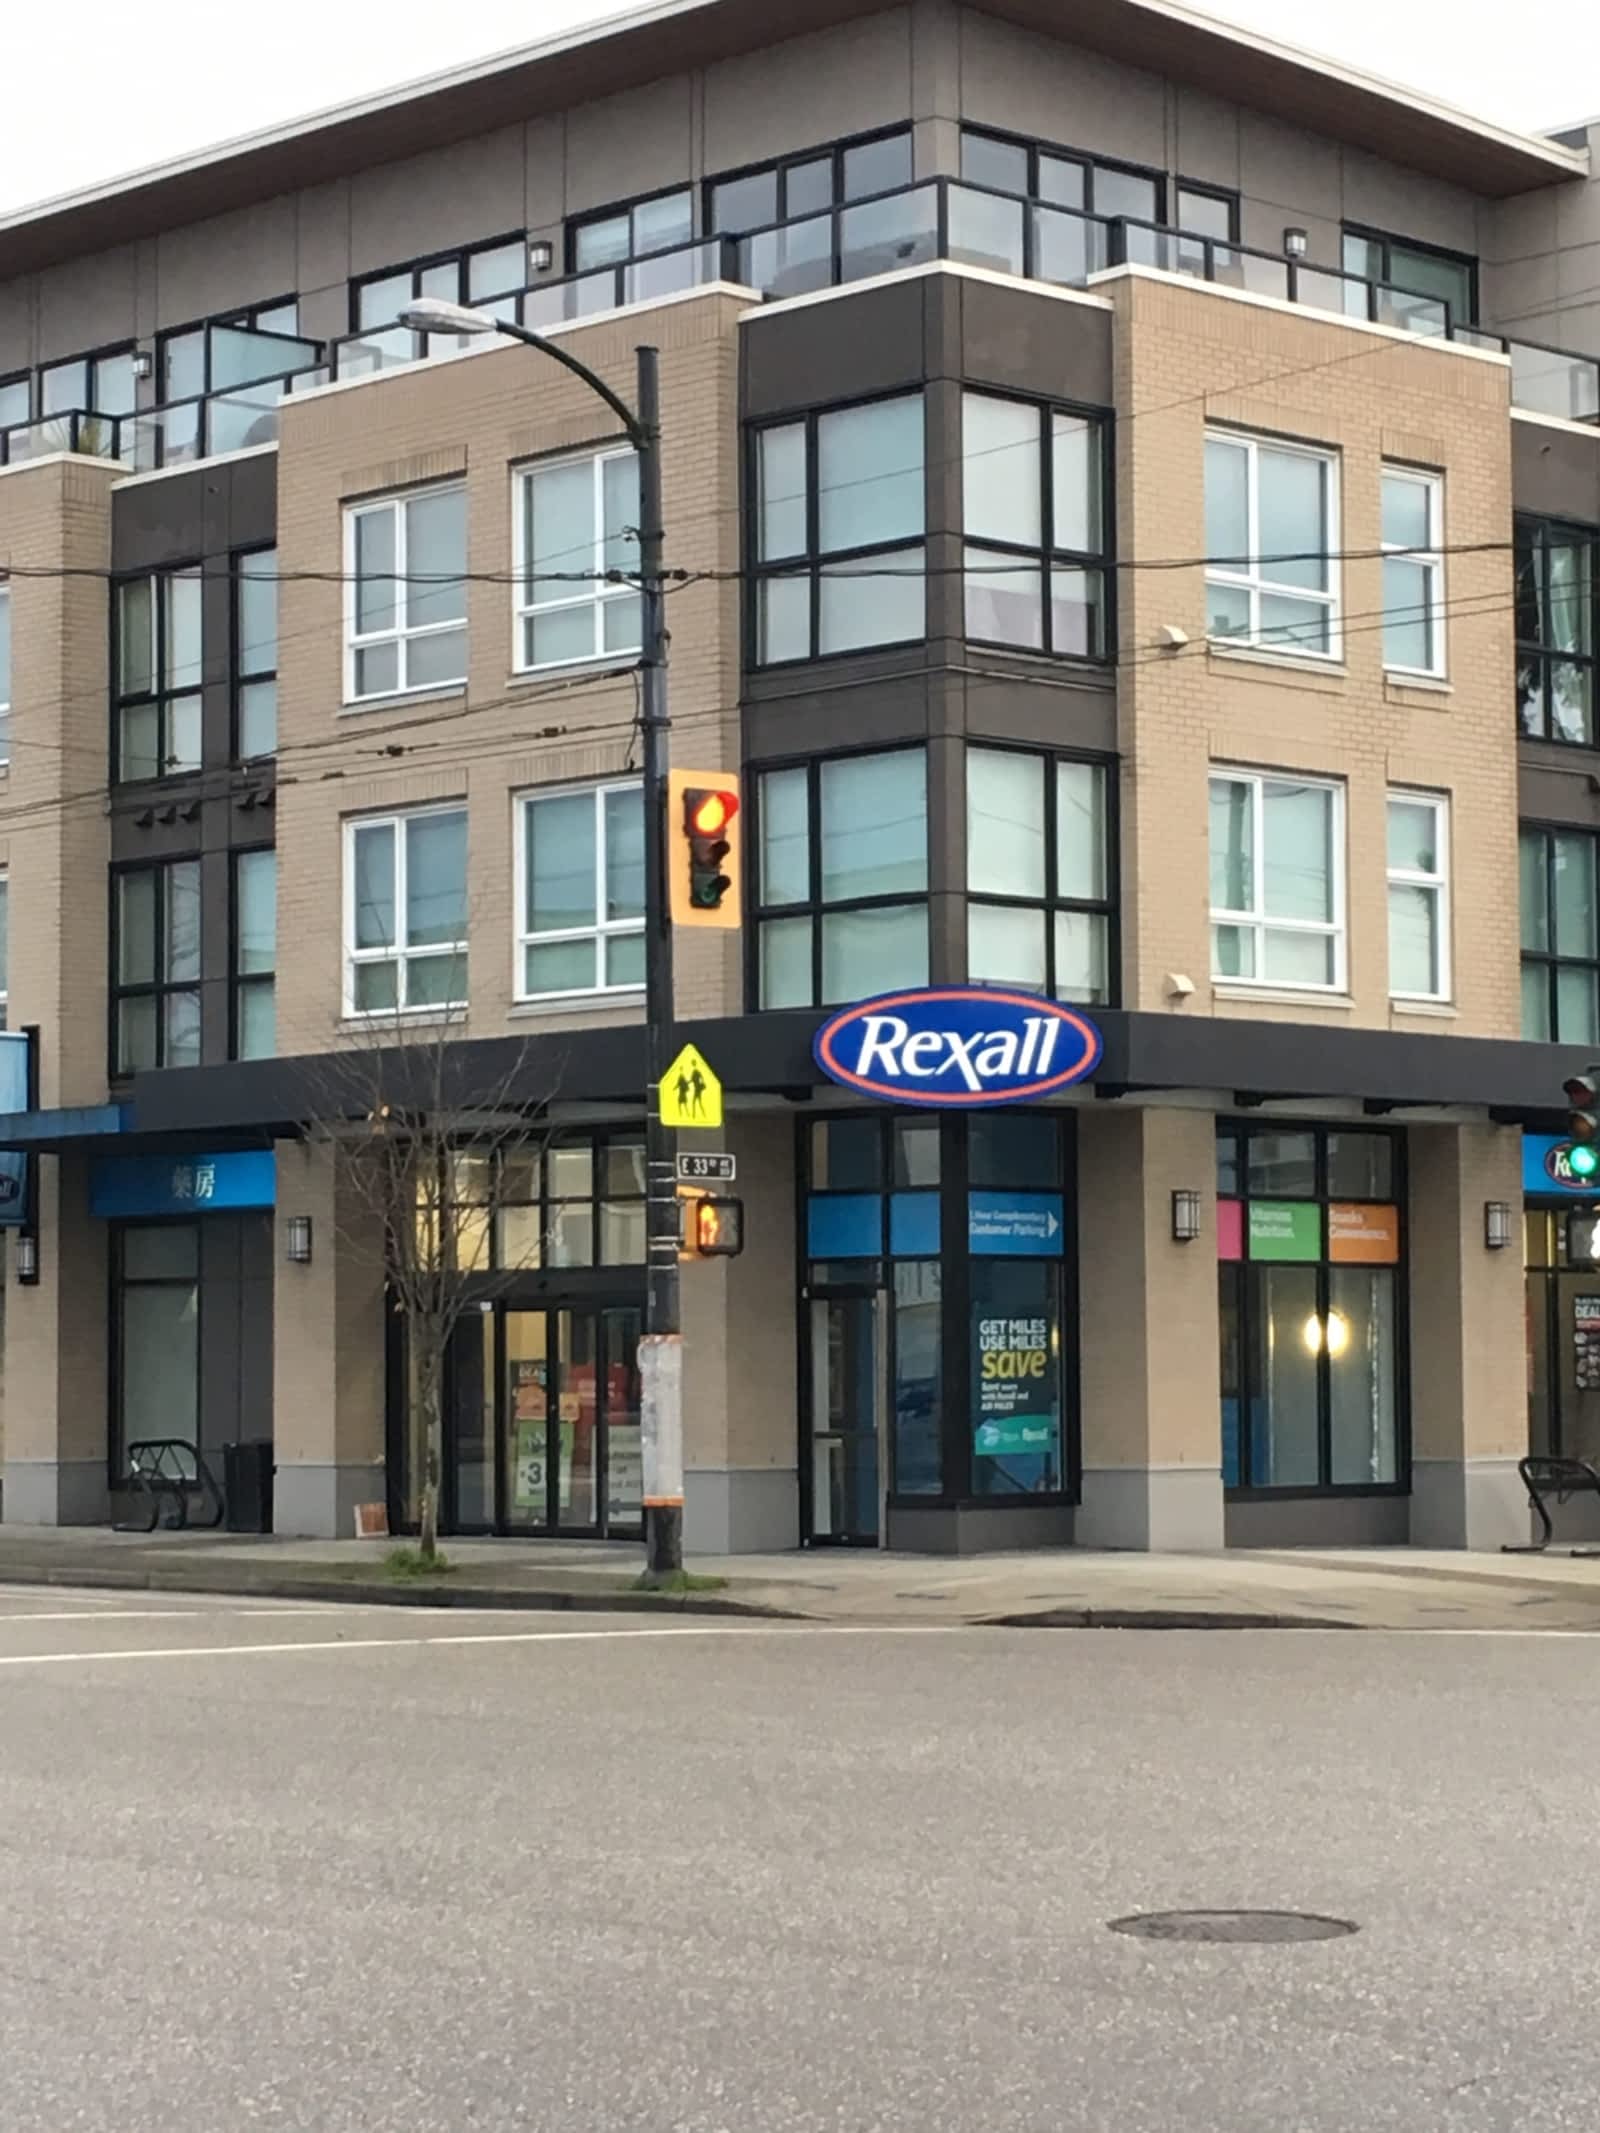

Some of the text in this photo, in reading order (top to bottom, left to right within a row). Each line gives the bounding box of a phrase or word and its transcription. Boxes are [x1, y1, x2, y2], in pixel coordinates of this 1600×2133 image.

[855, 1015, 1061, 1092] Rexall
[682, 1157, 690, 1174] E
[980, 1319, 1046, 1334] GET MILES
[980, 1335, 1046, 1350] USE MILES
[981, 1350, 1047, 1379] save
